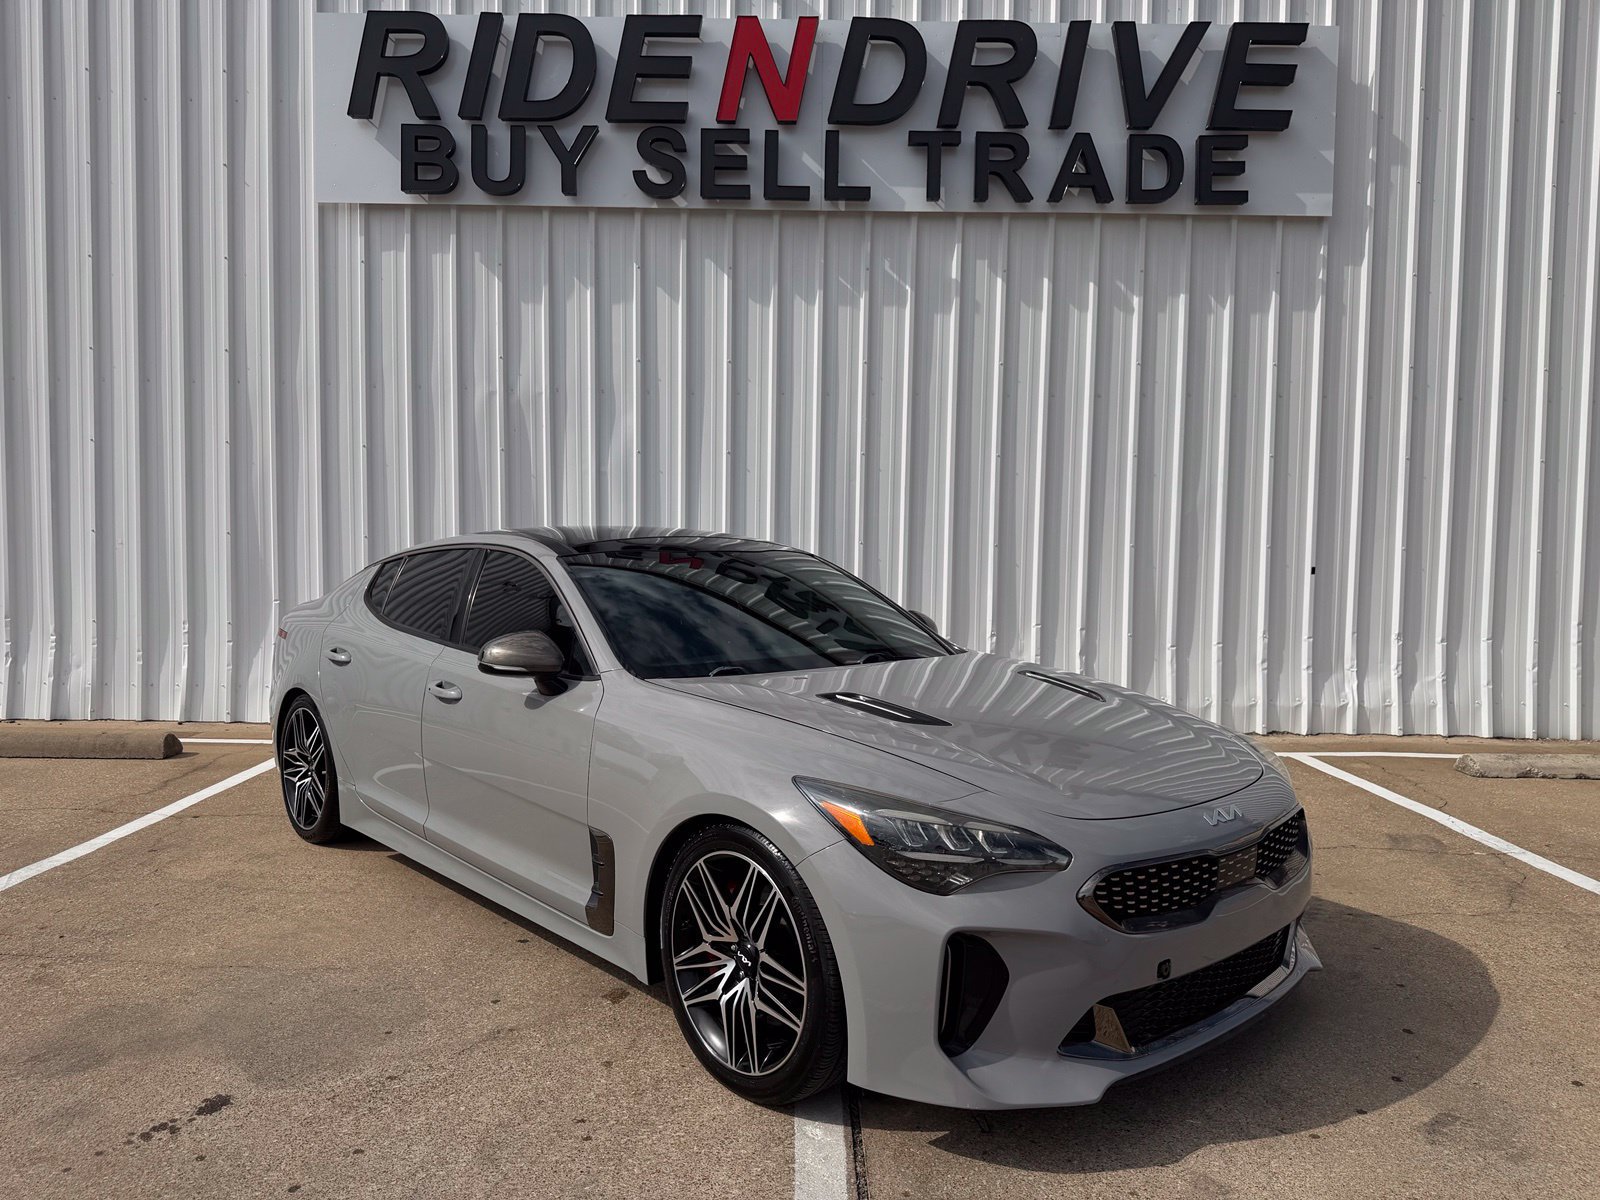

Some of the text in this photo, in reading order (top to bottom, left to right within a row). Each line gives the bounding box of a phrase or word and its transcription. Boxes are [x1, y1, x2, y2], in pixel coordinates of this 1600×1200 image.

[347, 10, 1310, 132] RIDENDRIVE
[401, 123, 1249, 205] BUY SELL TRADE
